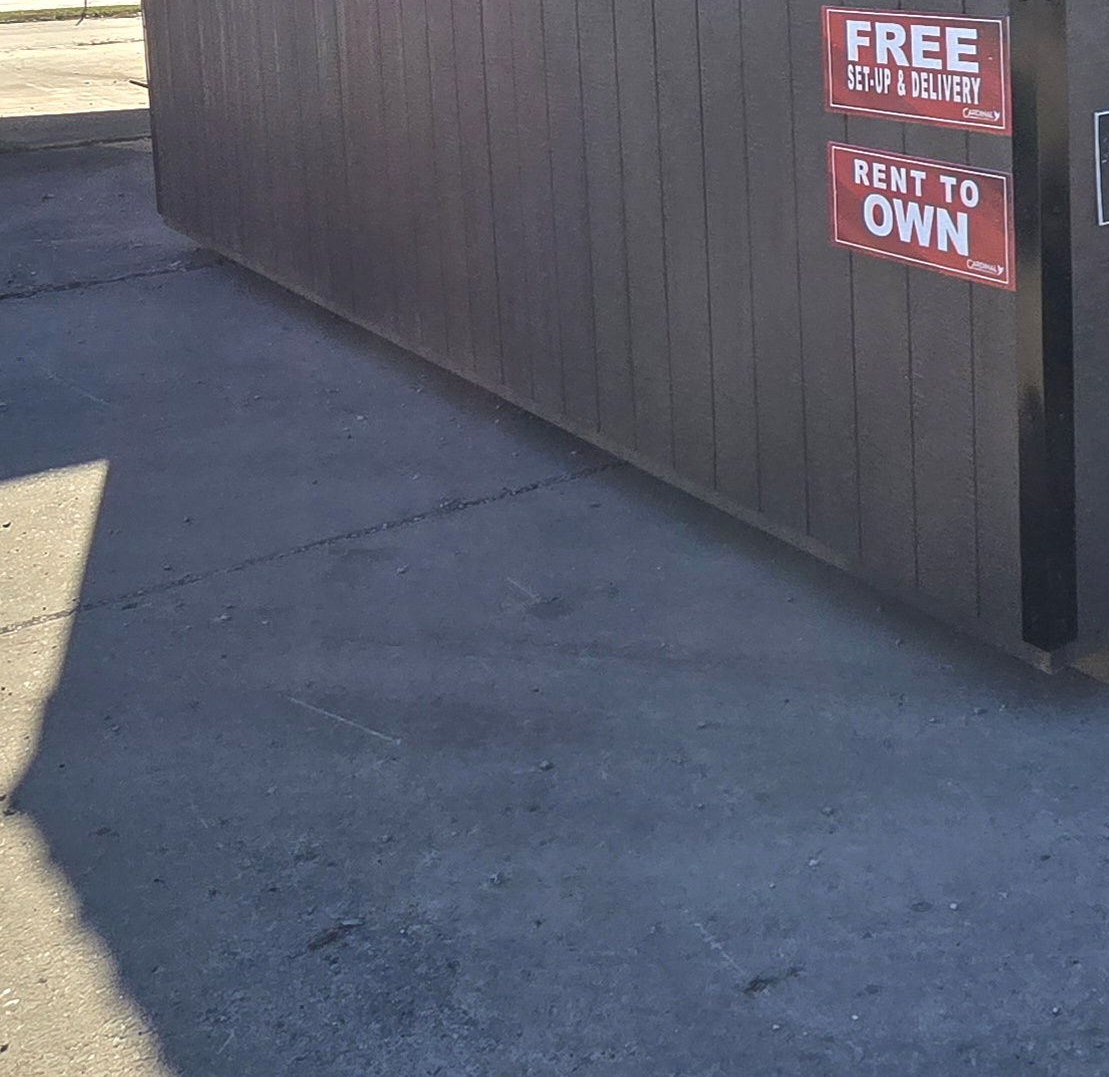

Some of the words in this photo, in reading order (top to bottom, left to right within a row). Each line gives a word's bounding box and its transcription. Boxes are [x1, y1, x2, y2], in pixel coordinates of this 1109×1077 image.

[846, 19, 979, 73] FREE
[847, 64, 891, 95] SET-UP
[897, 69, 906, 96] &
[911, 71, 981, 105] DELIVERY
[854, 158, 926, 197] RENT
[940, 175, 979, 208] TO
[863, 193, 969, 256] OWN
